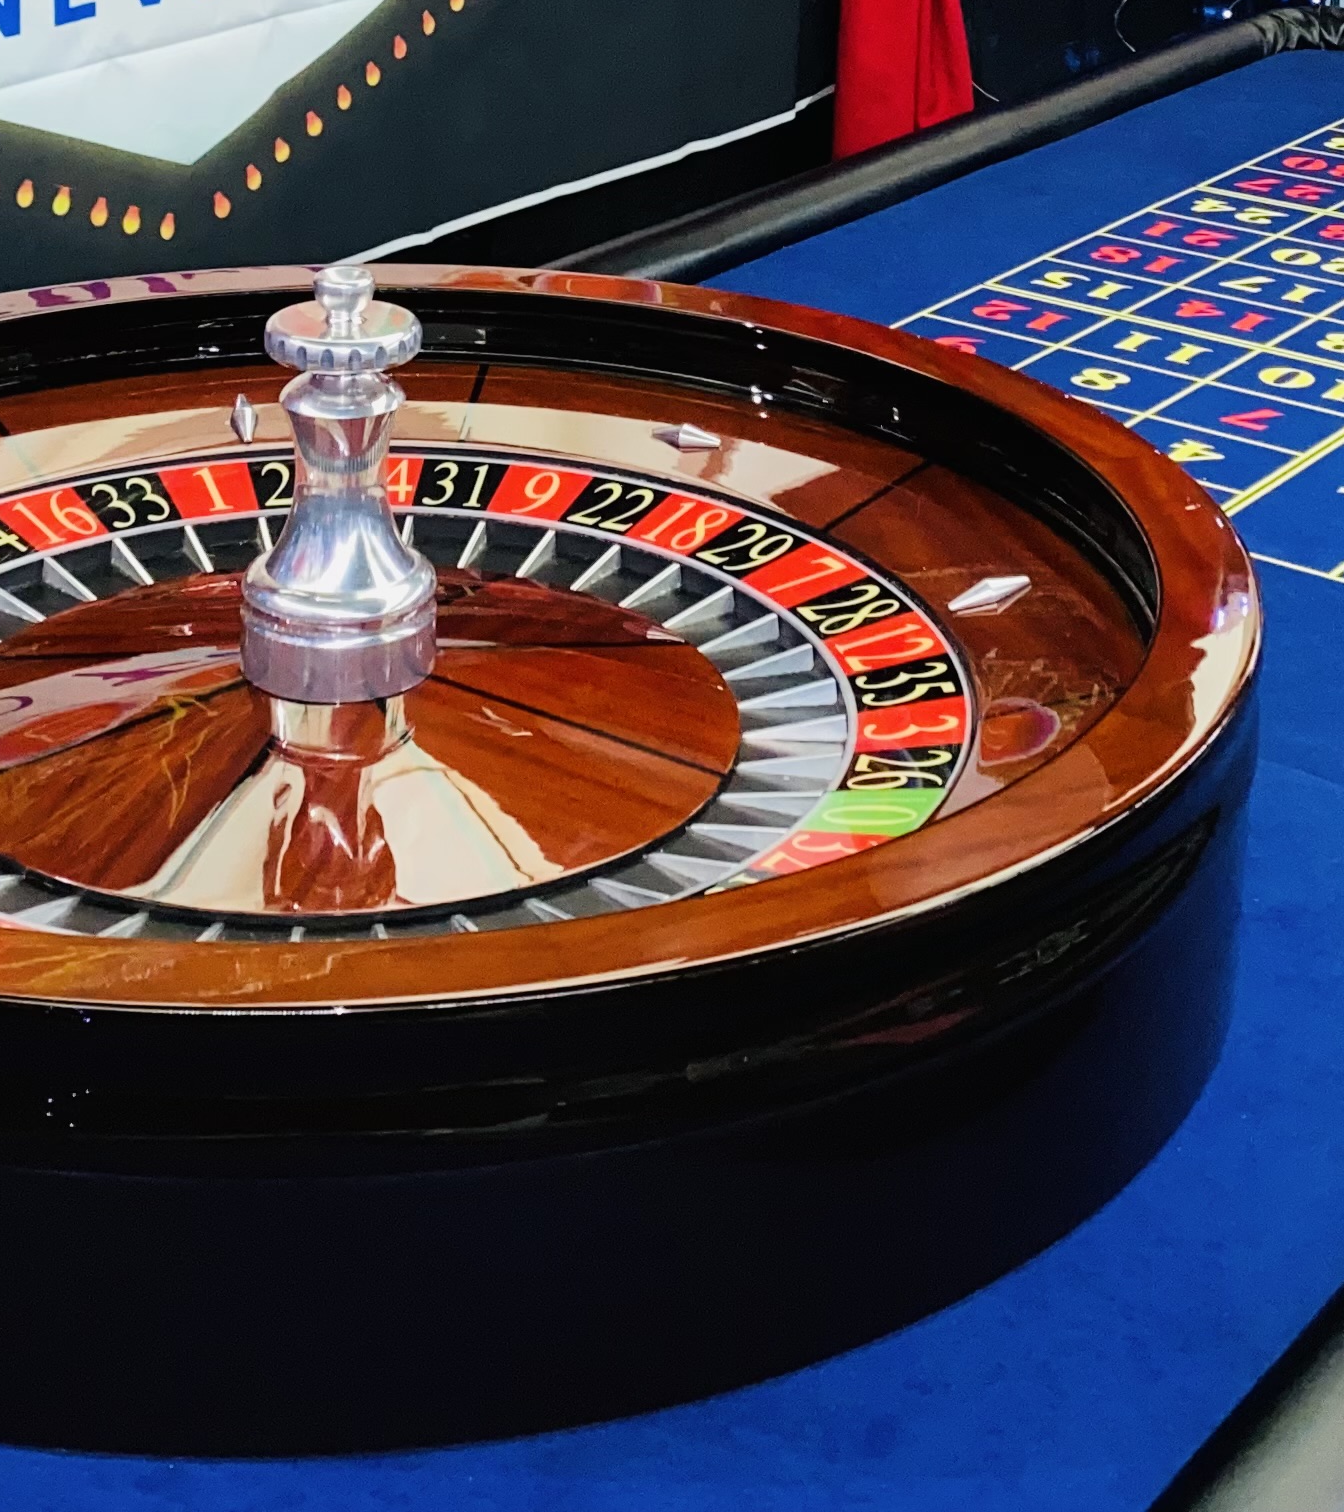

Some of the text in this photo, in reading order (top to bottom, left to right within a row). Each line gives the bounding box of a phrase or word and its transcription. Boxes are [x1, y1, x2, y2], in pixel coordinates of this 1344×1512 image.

[1233, 178, 1336, 201] 27
[1141, 220, 1239, 247] 21
[1089, 245, 1186, 274] 18
[1029, 270, 1134, 301] 15
[1218, 275, 1328, 304] 17
[971, 299, 1073, 332] 12
[1174, 299, 1276, 333] 14
[1113, 330, 1215, 365] 11
[1070, 367, 1132, 391] 8
[1219, 408, 1286, 431] 7
[1168, 438, 1226, 464] 4
[91, 476, 171, 529] 33
[193, 467, 235, 513] 1
[421, 461, 489, 508] 31
[511, 471, 561, 514] 9
[11, 490, 99, 545] 16
[566, 482, 655, 533] 22
[640, 501, 728, 551] 18
[695, 523, 794, 571] 29
[767, 556, 848, 594] 7
[796, 584, 901, 636] 28
[834, 623, 935, 672] 12
[855, 661, 956, 707] 35
[863, 714, 959, 741] 3
[846, 749, 953, 790] 26
[820, 804, 918, 826] 0
